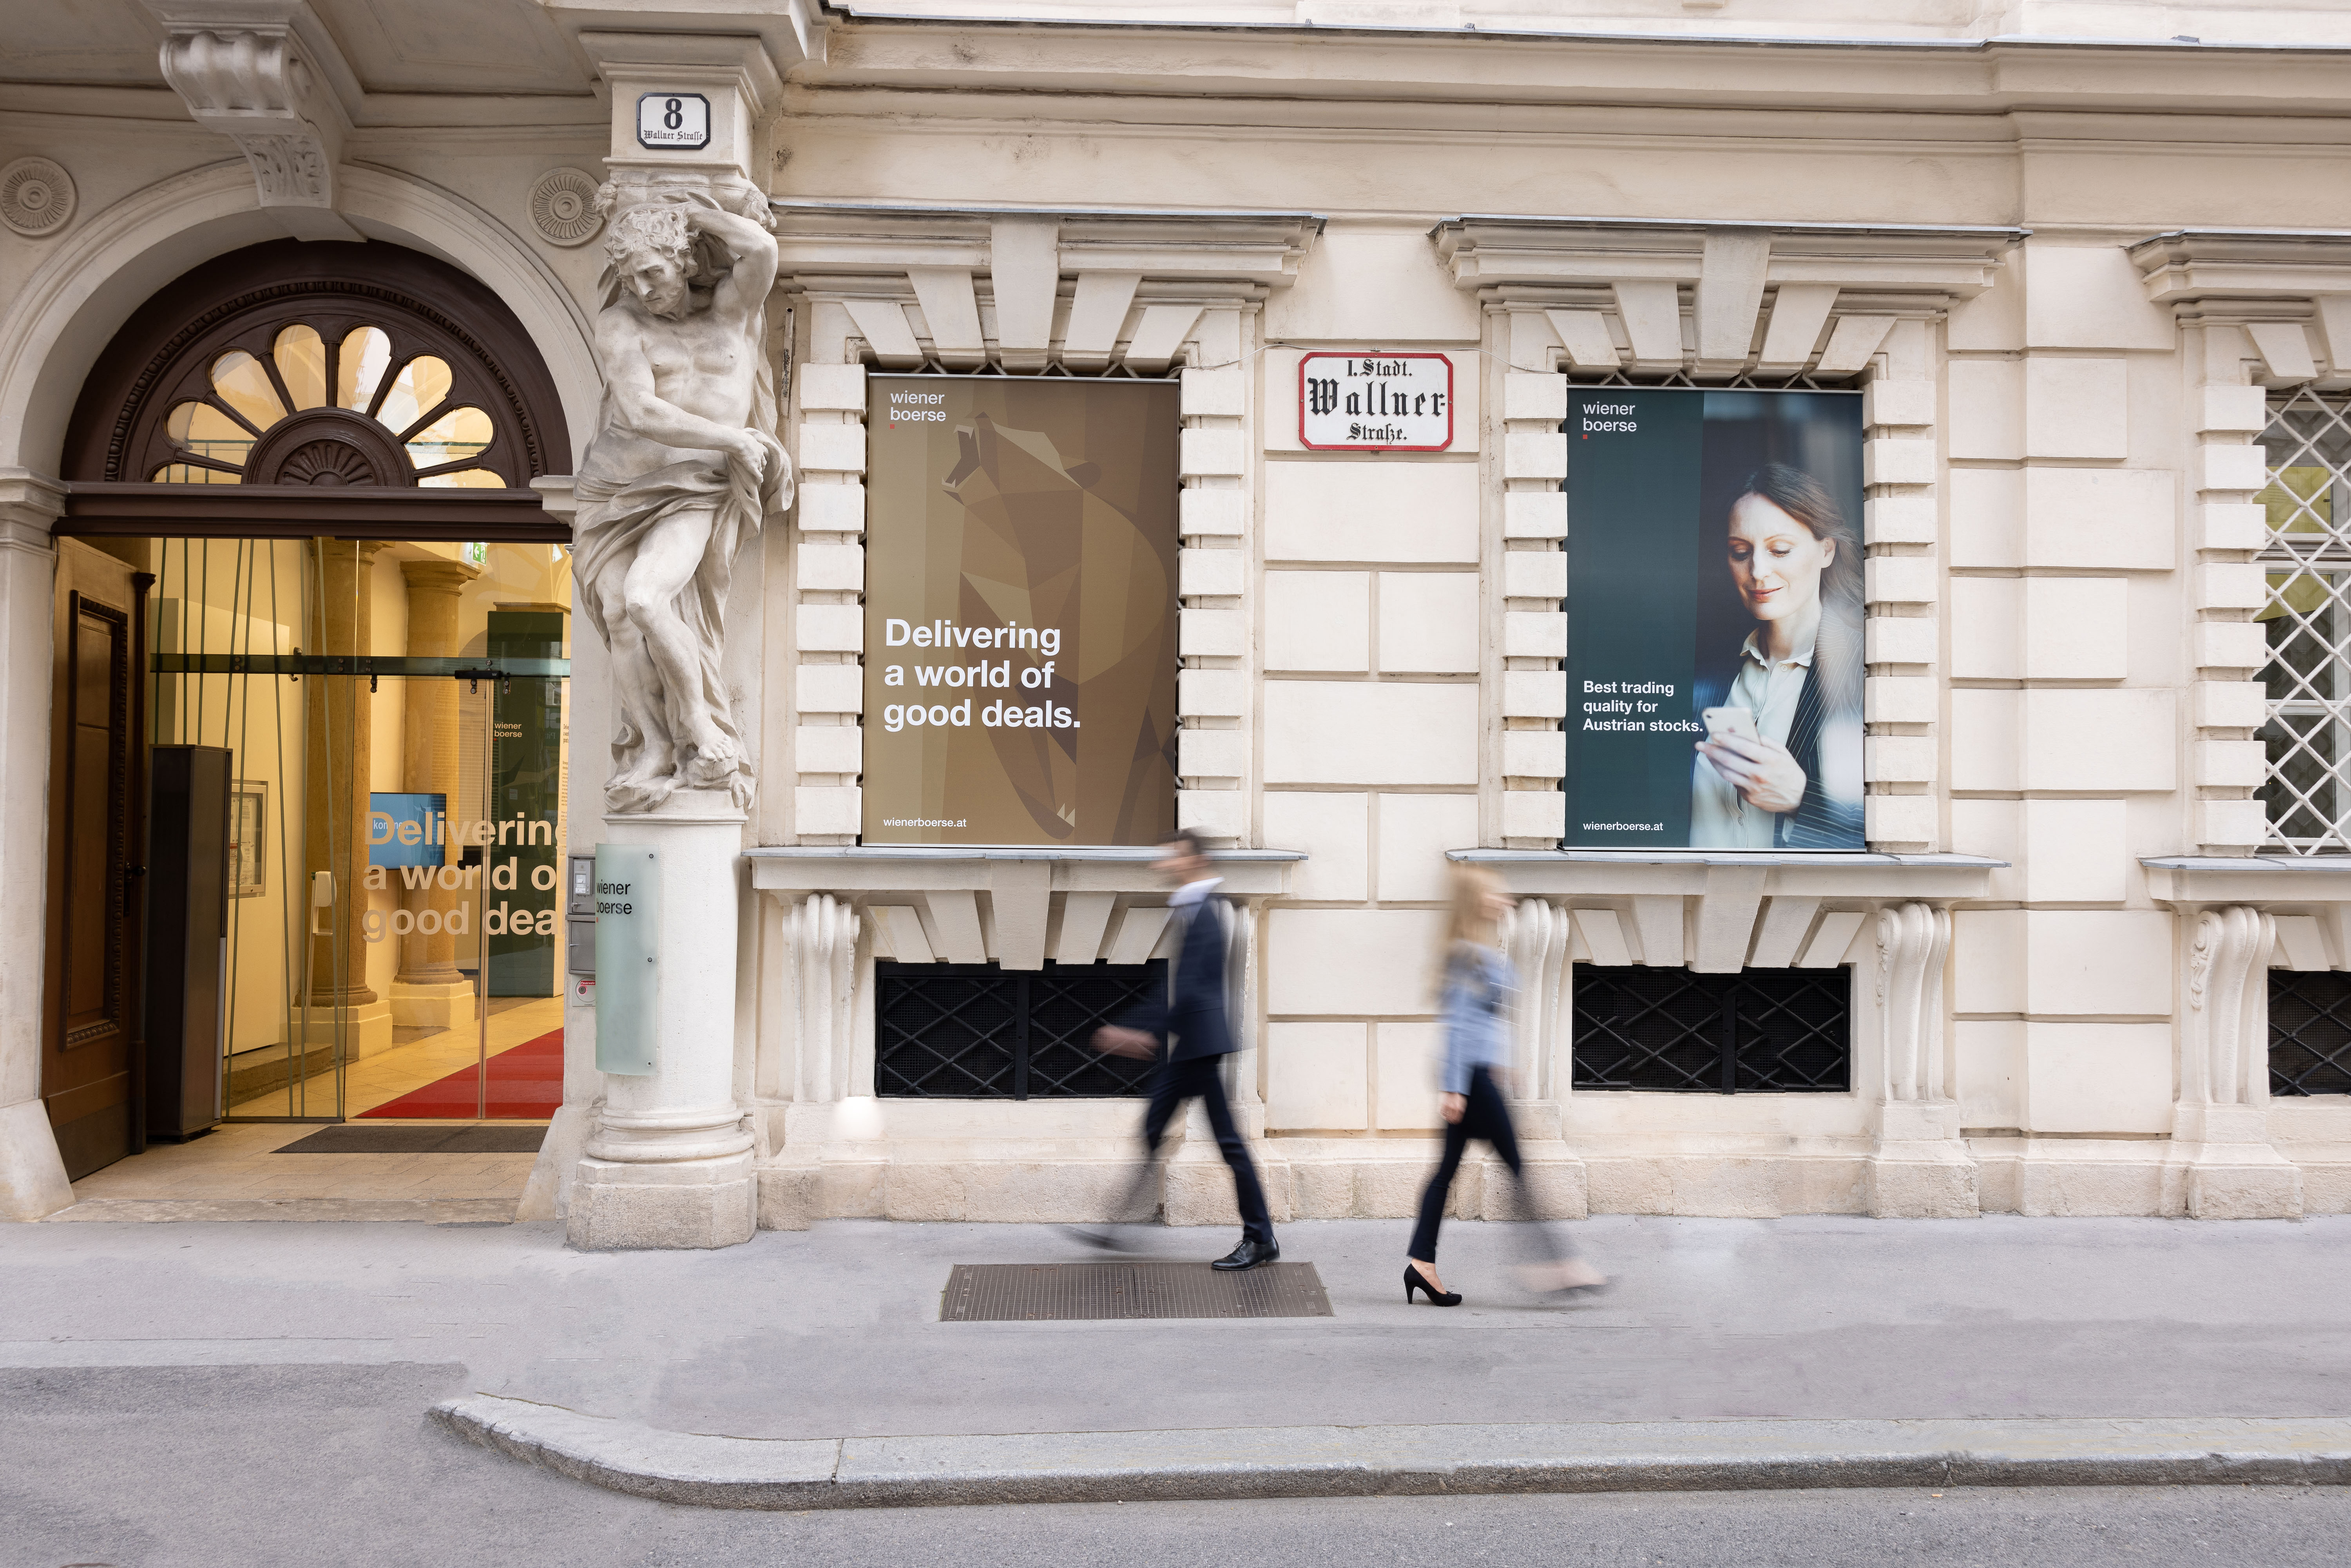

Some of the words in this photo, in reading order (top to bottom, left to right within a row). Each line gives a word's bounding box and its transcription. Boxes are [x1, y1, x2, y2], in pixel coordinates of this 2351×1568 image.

[664, 98, 683, 130] 8
[643, 130, 674, 139] Wallner
[890, 390, 945, 404] wiener
[890, 407, 946, 422] boerse
[1583, 401, 1636, 415] wiener
[1583, 417, 1637, 432] boerse
[886, 618, 1060, 655] Delivering
[884, 665, 904, 686] a
[914, 660, 1010, 688] world
[1021, 661, 1055, 688] of
[1583, 681, 1617, 693] Best
[1621, 681, 1674, 697] trading
[1583, 700, 1633, 715] quality
[1636, 700, 1658, 713] for
[884, 699, 971, 732] good
[982, 699, 1080, 728] deals.
[1583, 719, 1645, 731] Austrian
[1649, 719, 1703, 732] stocks.
[883, 817, 967, 827] wienerboerse.at
[1583, 821, 1663, 831] wienerboerse.at
[363, 864, 387, 890] a
[400, 856, 517, 890] world
[596, 879, 631, 895] wiener
[596, 898, 632, 914] boerse
[362, 901, 469, 943] good
